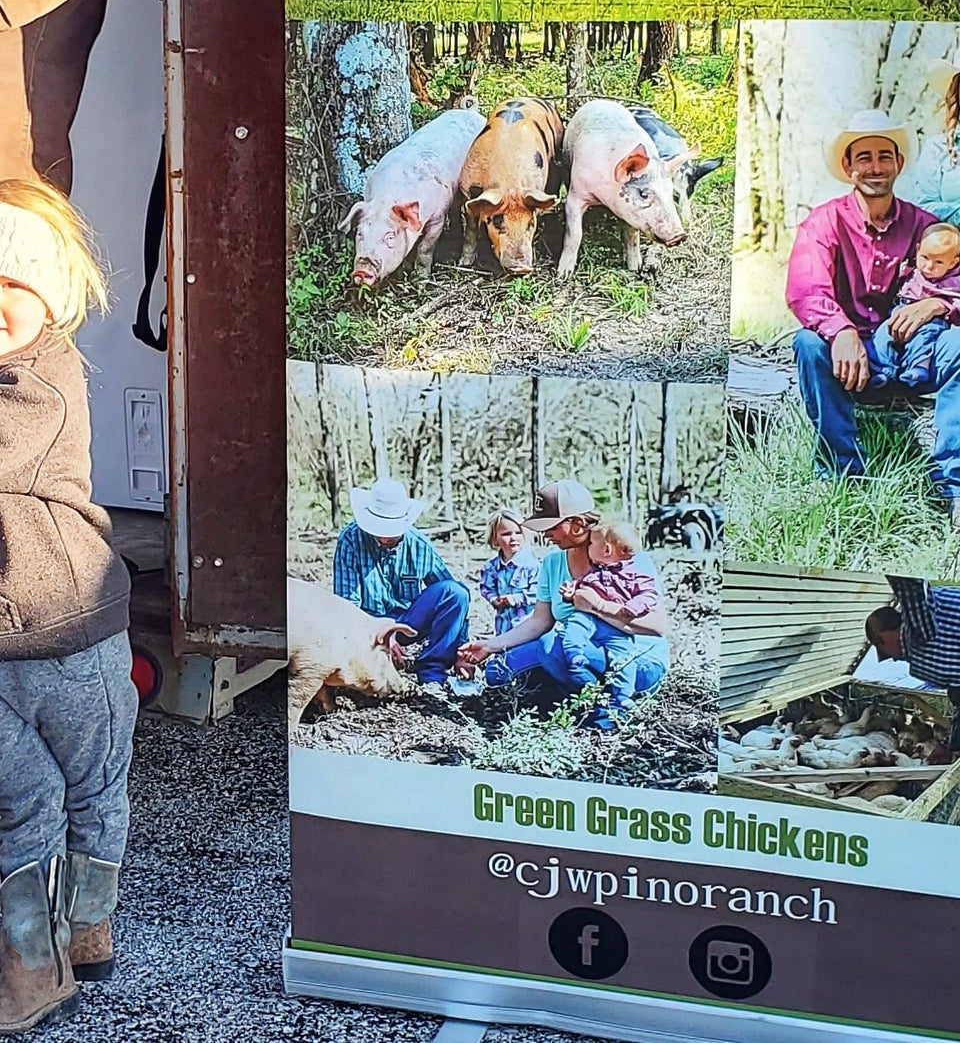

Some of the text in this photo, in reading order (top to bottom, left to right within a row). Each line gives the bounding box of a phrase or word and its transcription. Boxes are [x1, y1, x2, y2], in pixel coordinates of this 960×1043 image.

[473, 783, 869, 867] Green Grass Chickens
[488, 853, 839, 925] @cjwpinoranch
